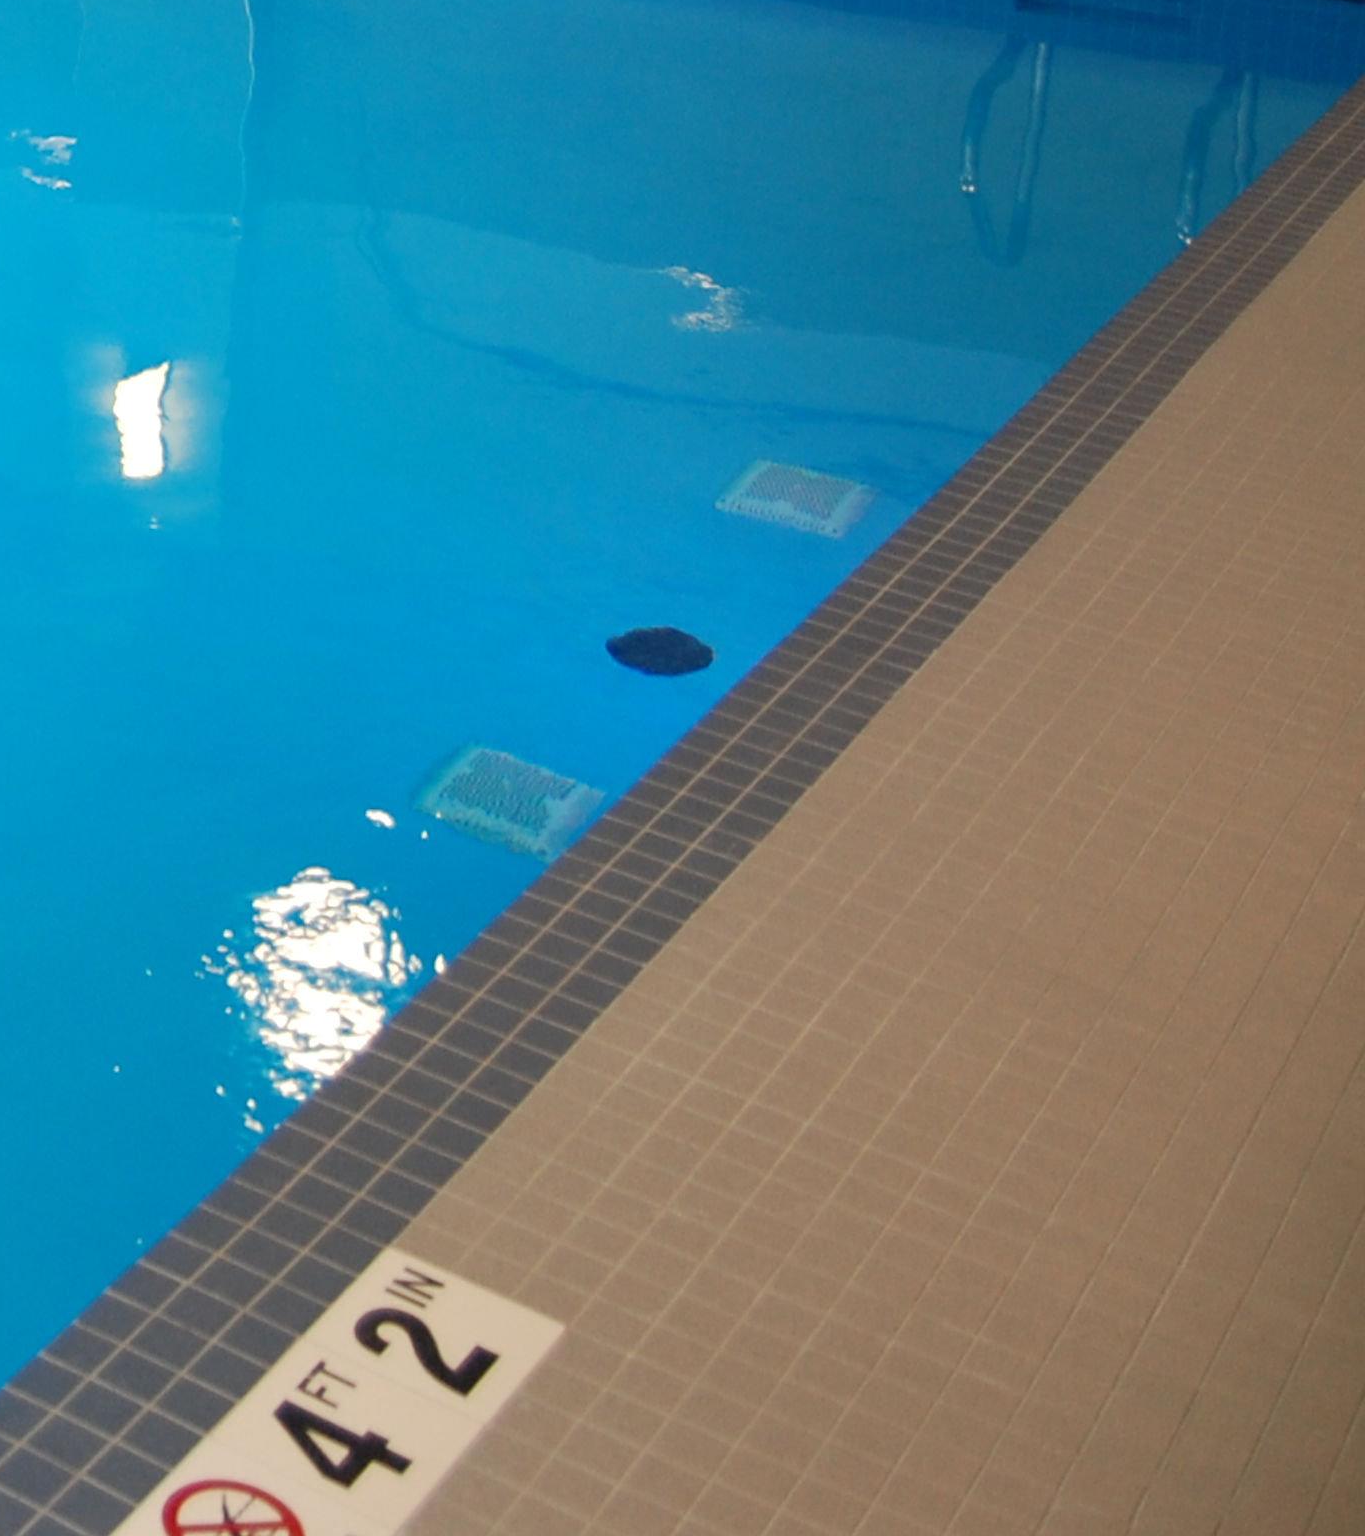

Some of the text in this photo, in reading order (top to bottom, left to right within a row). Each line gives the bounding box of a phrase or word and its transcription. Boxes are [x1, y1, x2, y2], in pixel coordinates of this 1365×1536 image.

[273, 1266, 501, 1489] 4 FT 2 IN
